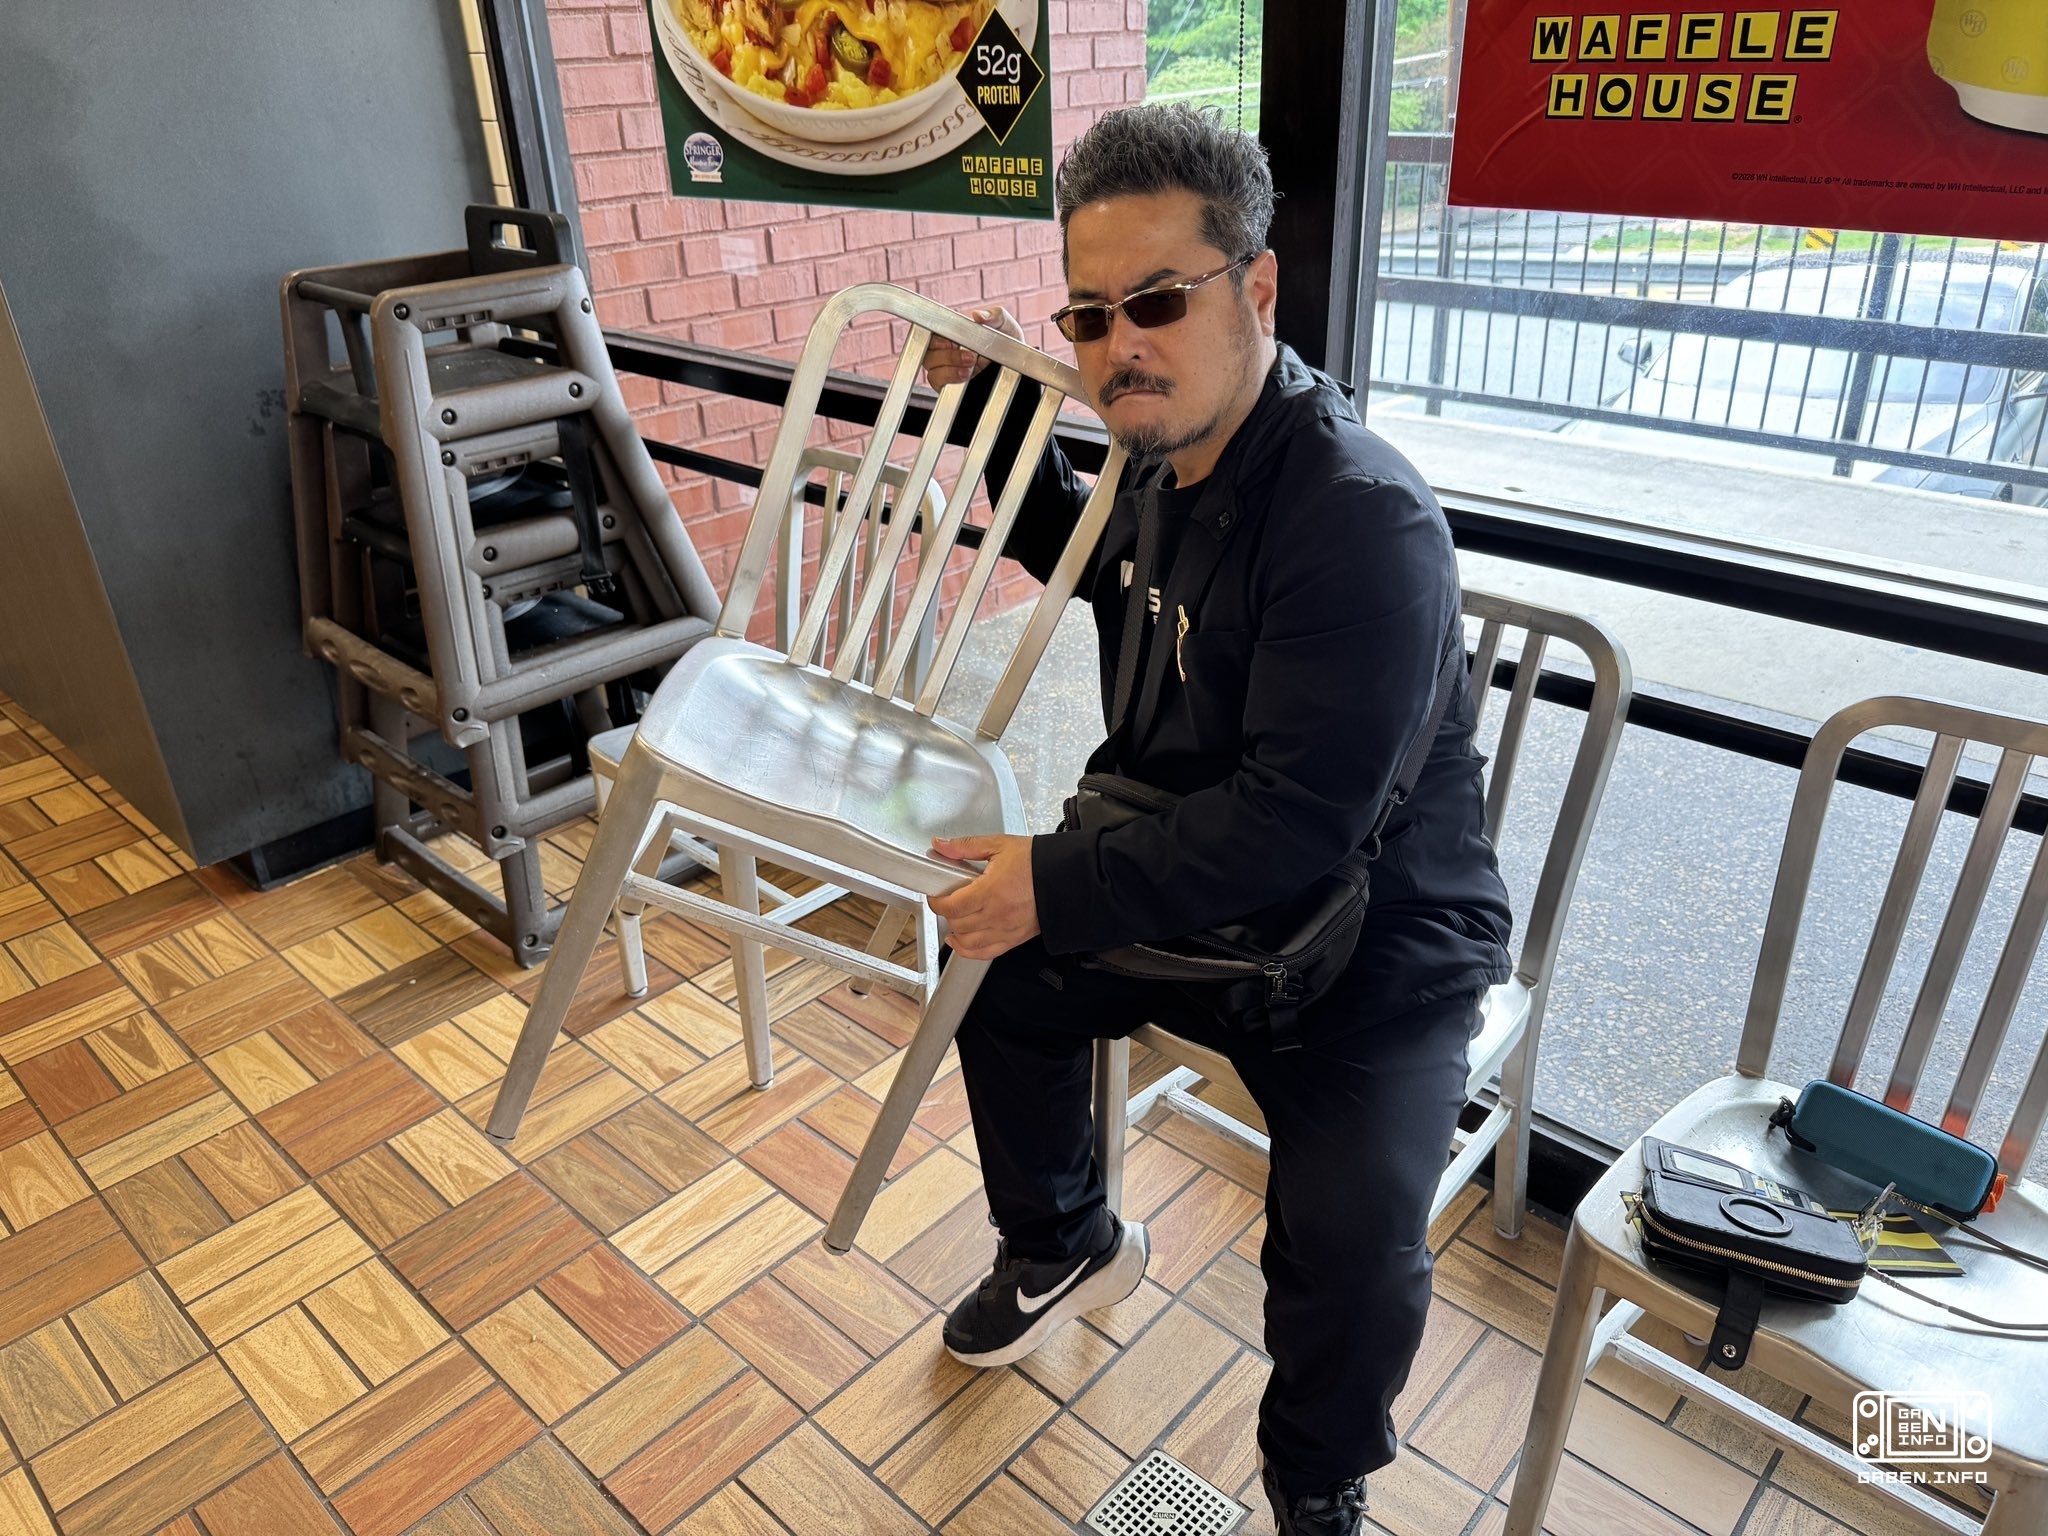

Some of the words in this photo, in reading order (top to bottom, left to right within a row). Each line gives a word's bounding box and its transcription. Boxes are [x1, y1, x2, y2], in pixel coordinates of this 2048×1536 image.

[1539, 16, 1829, 55] WAFFLE
[977, 44, 1022, 84] 52g
[977, 85, 1021, 105] PROTEIN
[963, 157, 1041, 175] WAFFLE
[971, 179, 1035, 196] HOUSE
[1809, 176, 1823, 184] LLC
[1853, 178, 1894, 188] trademarks
[1909, 182, 1935, 190] owned
[1936, 183, 1947, 191] by
[1947, 183, 1961, 191] WH
[2009, 185, 2025, 193] LLC
[2026, 186, 2042, 195] and
